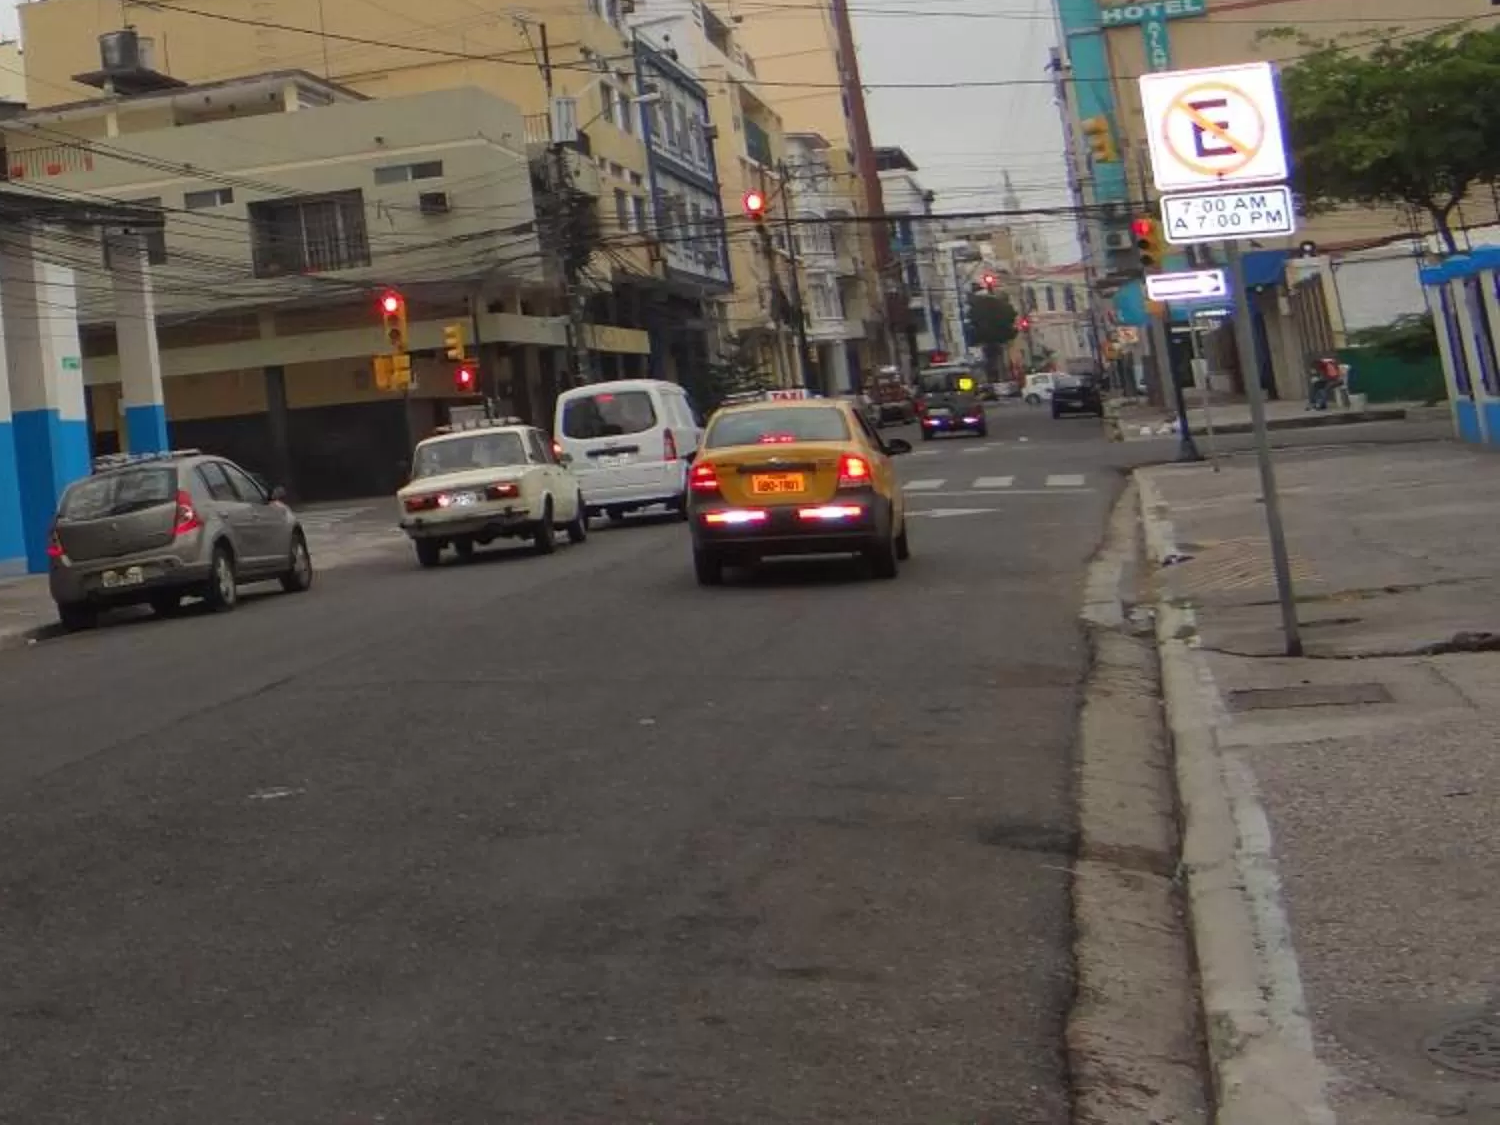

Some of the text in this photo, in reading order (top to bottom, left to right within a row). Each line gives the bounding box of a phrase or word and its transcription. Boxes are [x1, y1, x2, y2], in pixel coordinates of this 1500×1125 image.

[1188, 99, 1236, 157] E
[1181, 195, 1267, 215] 7:00 AM
[1174, 210, 1283, 231] A 7:00 PM
[771, 391, 804, 400] TAXI
